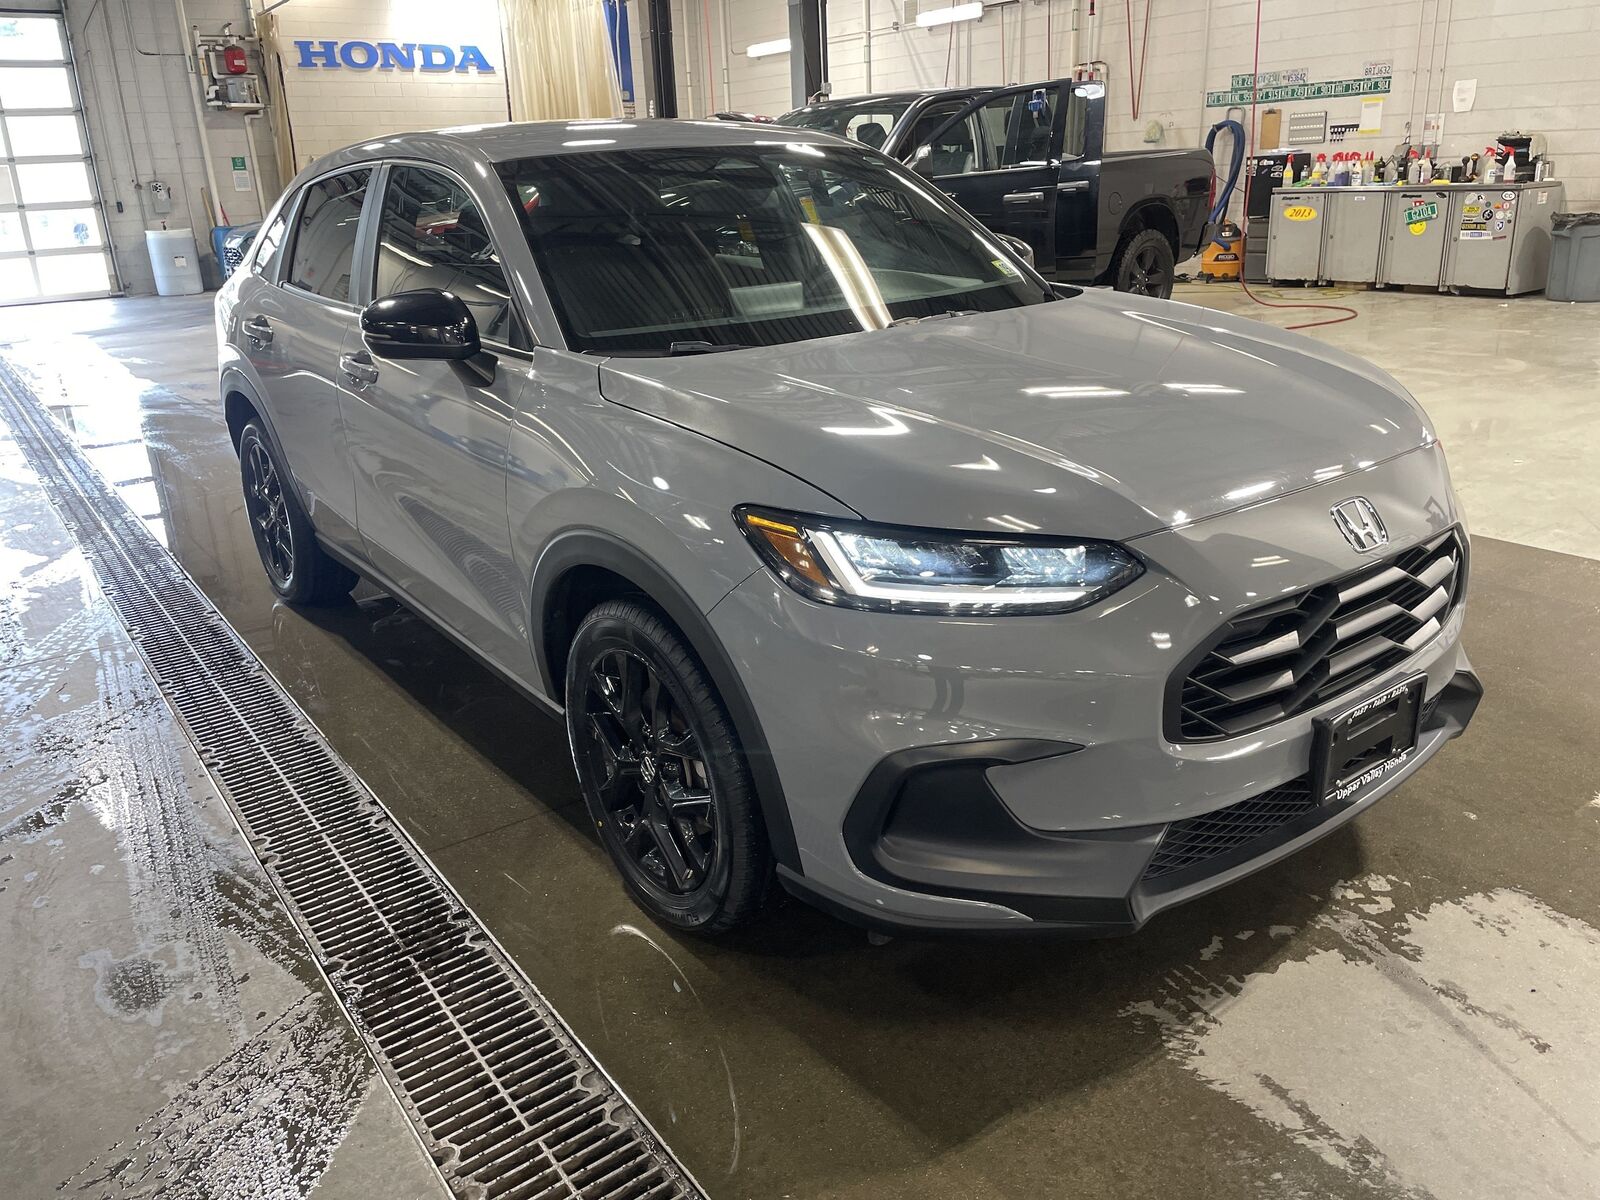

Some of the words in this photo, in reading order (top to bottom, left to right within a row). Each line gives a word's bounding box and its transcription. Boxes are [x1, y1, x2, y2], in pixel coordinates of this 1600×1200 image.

[293, 40, 496, 73] HONDA
[1289, 208, 1313, 218] 2013
[1335, 779, 1361, 800] Upper
[1361, 766, 1384, 785] Valley
[1384, 753, 1407, 771] Honda
